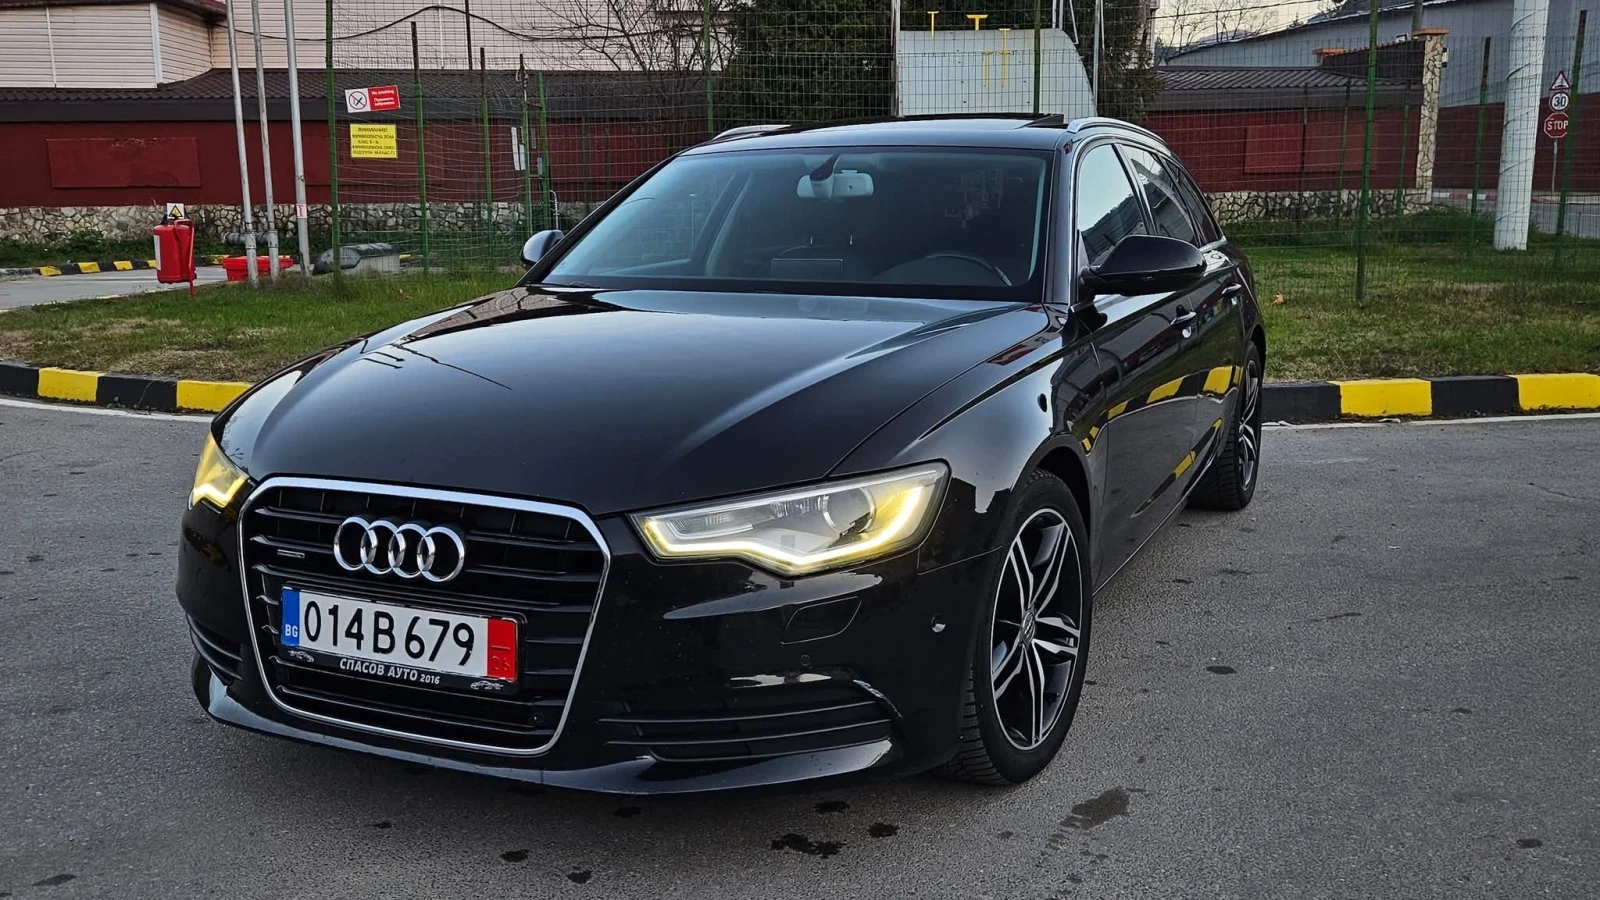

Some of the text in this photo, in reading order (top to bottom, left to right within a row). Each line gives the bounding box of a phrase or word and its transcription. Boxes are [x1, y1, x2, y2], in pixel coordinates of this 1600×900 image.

[1554, 96, 1567, 107] 30
[1547, 120, 1568, 130] STOP
[285, 624, 298, 637] BG
[304, 600, 475, 666] 014B679
[340, 658, 440, 685] СПАСОВ АУТО 2016
